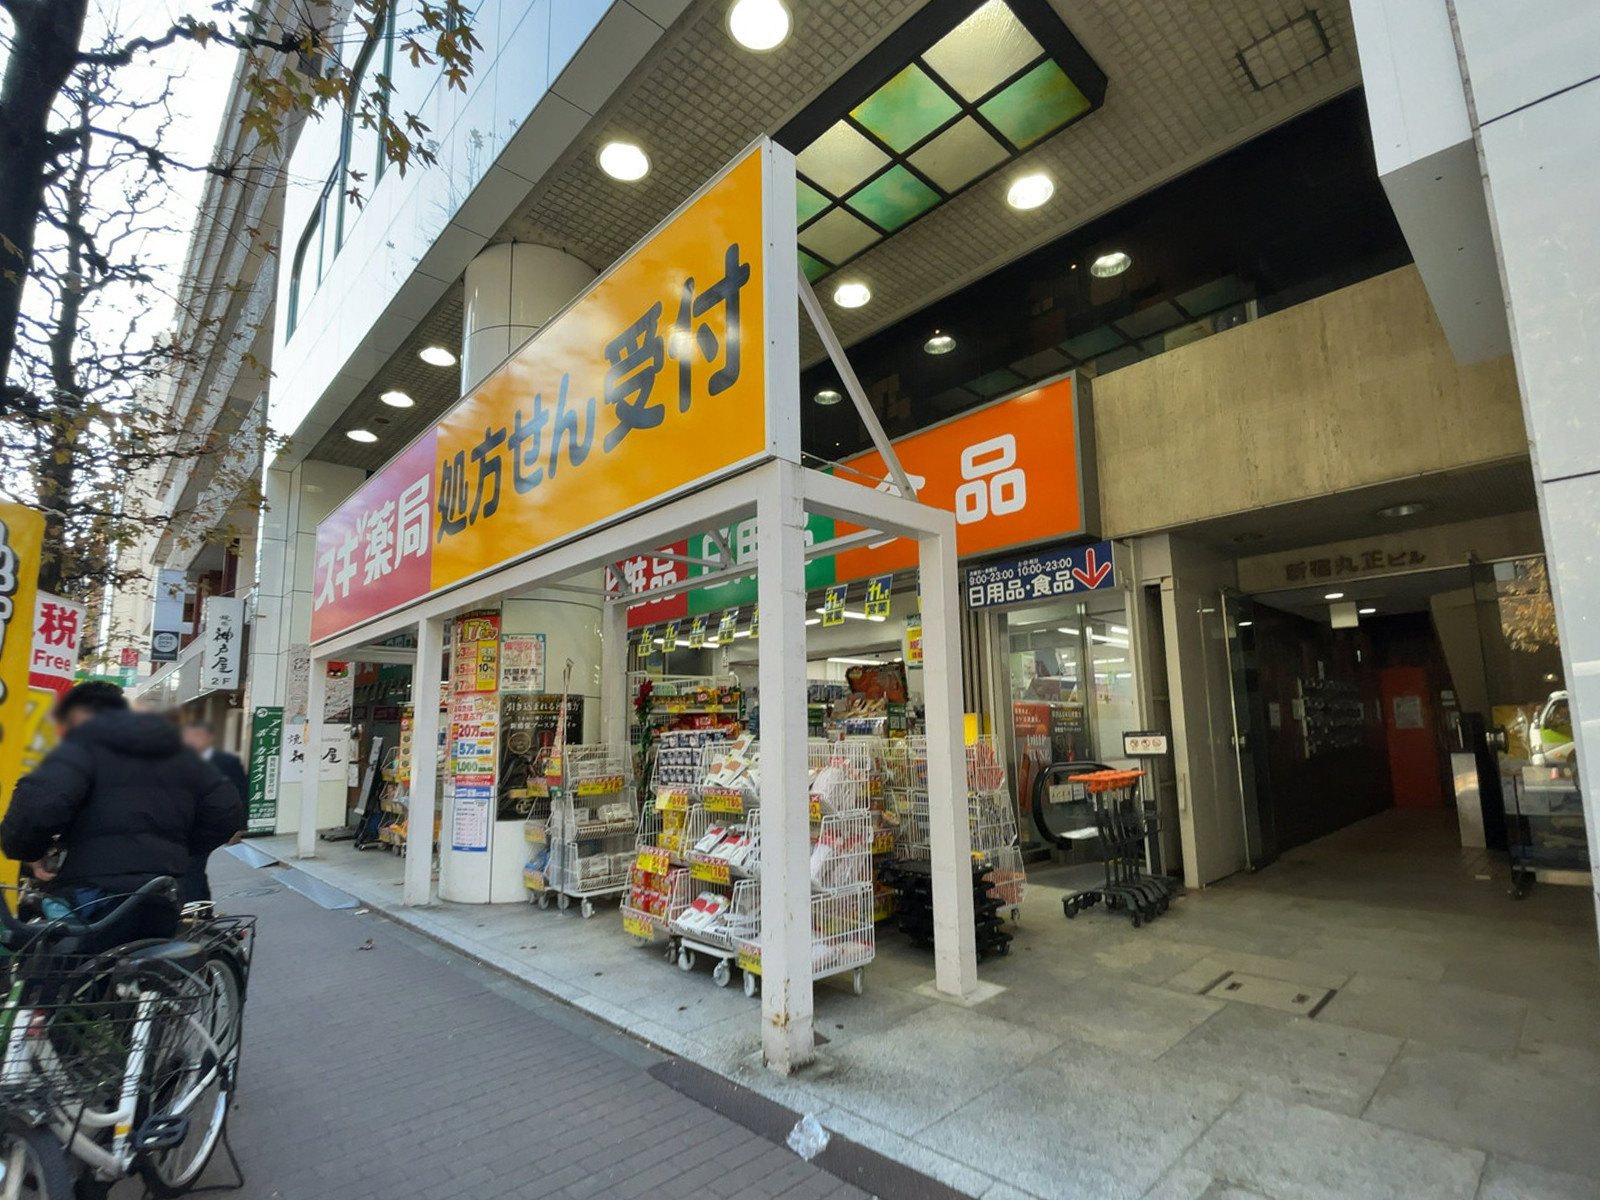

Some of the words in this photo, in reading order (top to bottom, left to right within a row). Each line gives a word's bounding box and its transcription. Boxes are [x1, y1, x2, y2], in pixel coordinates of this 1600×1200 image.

[437, 243, 750, 544] 処方せん受付
[314, 473, 430, 612] スギ薬局
[1286, 550, 1426, 582] 新宿丸正ビル
[969, 570, 1075, 607] 日用品・食品
[34, 649, 71, 672] Free
[211, 627, 234, 674] 神戸屋
[211, 677, 231, 686] 2F
